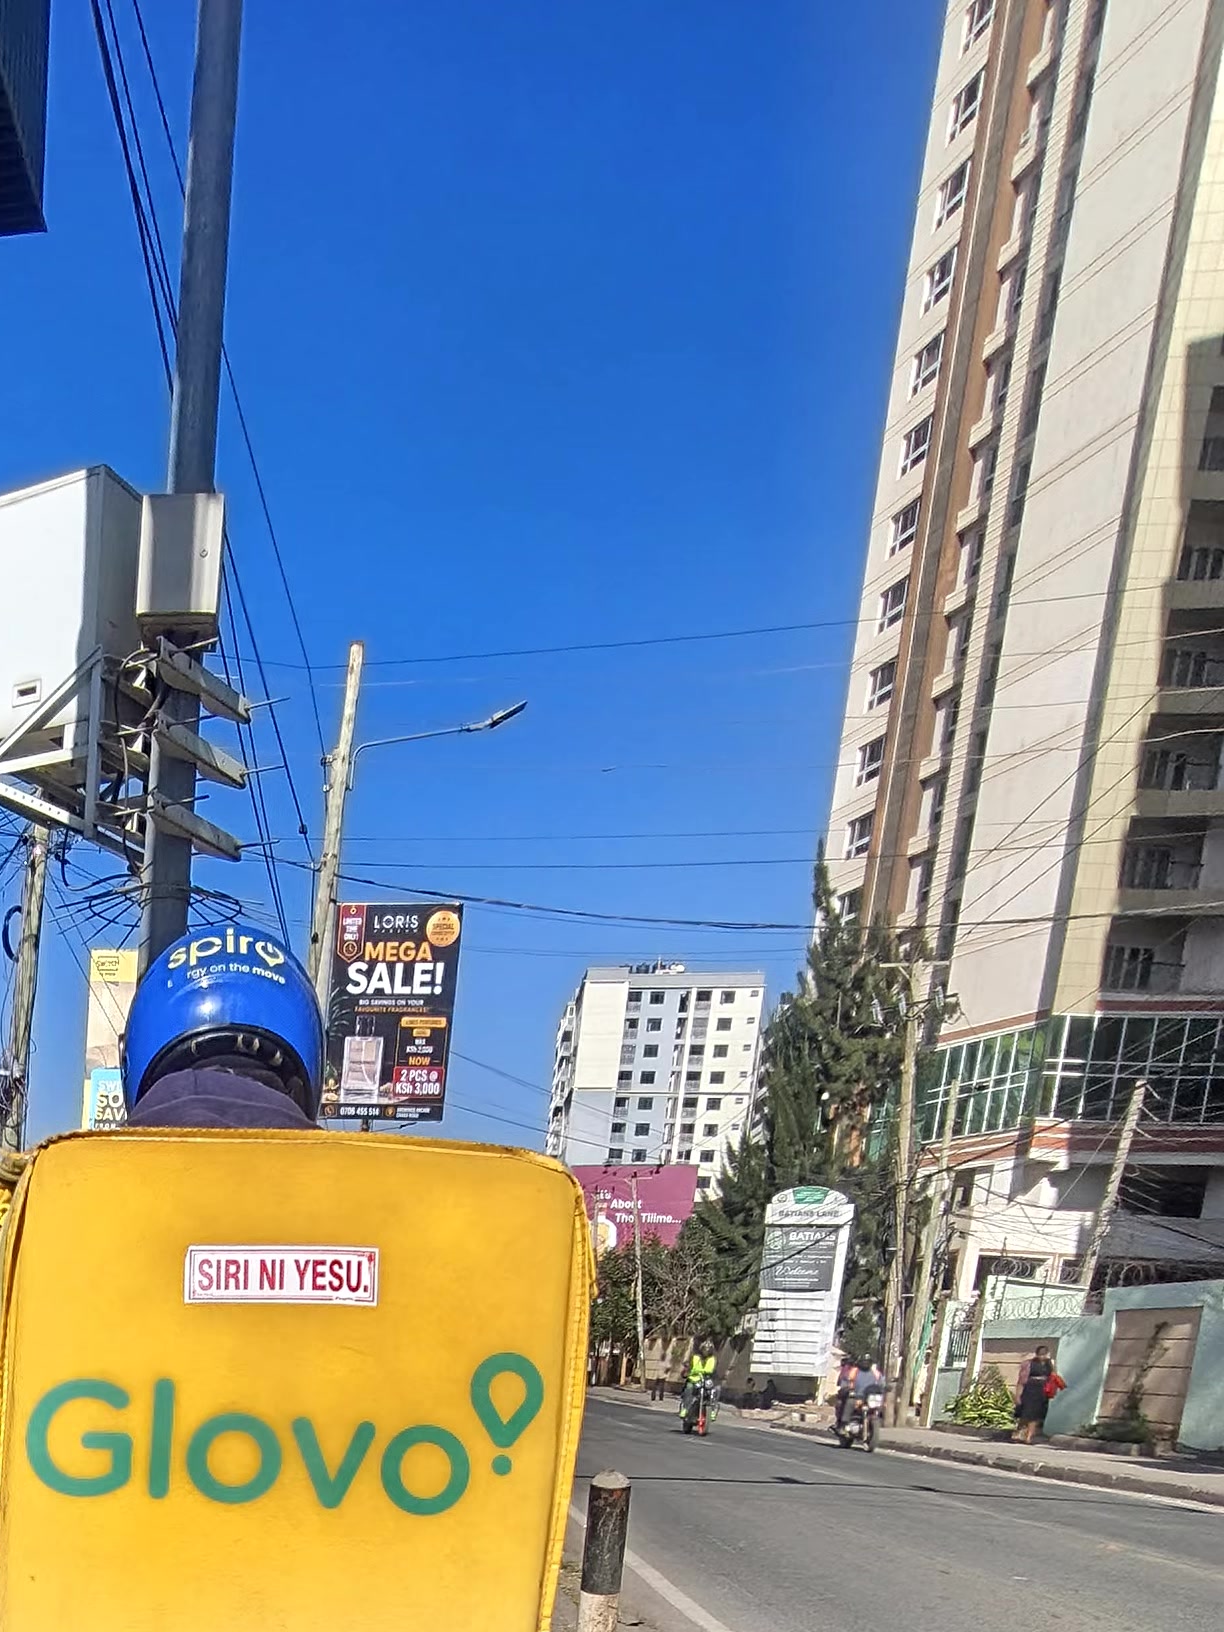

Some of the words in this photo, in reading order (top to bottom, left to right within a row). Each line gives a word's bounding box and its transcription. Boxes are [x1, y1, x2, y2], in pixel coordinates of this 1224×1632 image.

[374, 915, 419, 929] LORIS
[364, 941, 433, 961] MEGA
[209, 963, 226, 973] on
[229, 962, 250, 974] the
[252, 966, 287, 985] move
[345, 961, 445, 995] SALE!
[408, 1056, 431, 1066] NOW
[400, 1069, 407, 1081] 2
[409, 1069, 428, 1080] PCS
[395, 1082, 413, 1095] KSh
[414, 1082, 440, 1096] 3,000
[198, 1258, 249, 1292] SIRI
[259, 1258, 285, 1291] NI
[294, 1258, 369, 1294] YESU.
[26, 1376, 471, 1517] Glovo
